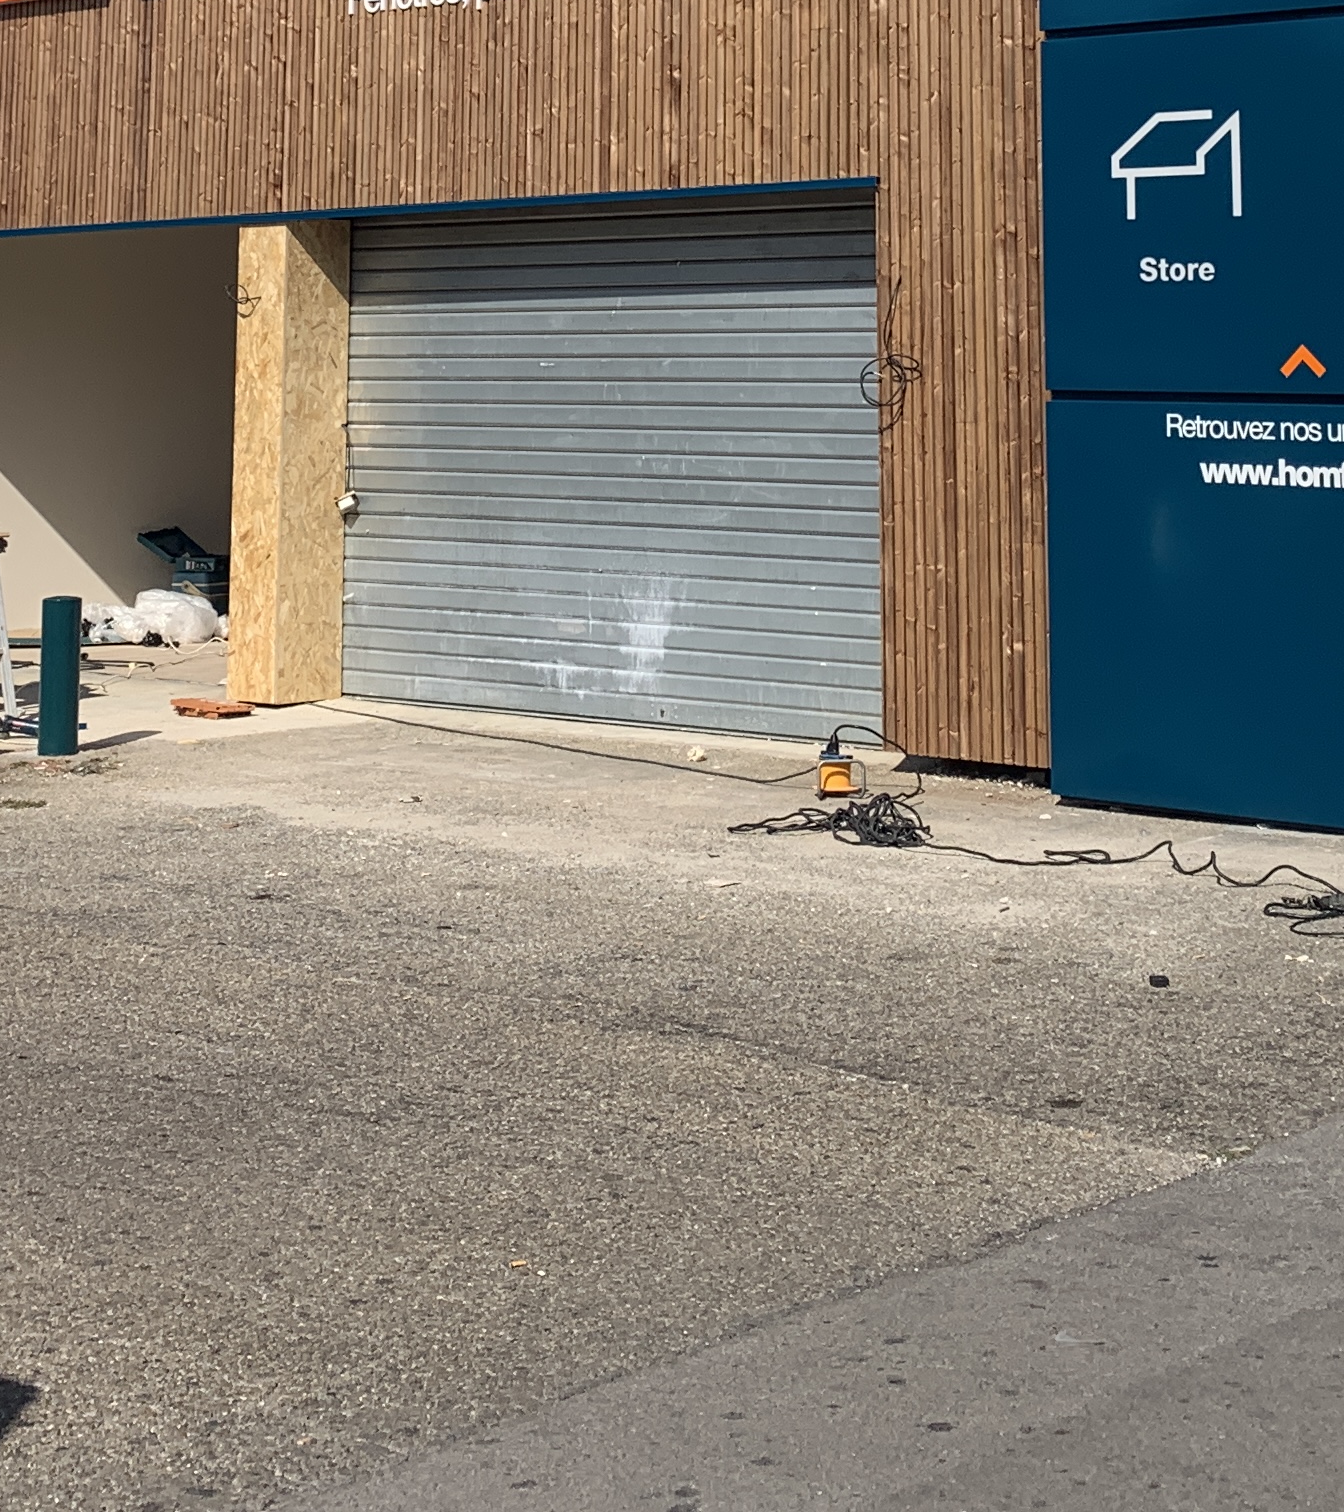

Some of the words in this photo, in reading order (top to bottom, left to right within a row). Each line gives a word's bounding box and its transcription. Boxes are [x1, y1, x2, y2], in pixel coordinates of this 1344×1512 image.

[1139, 257, 1215, 282] Store
[1166, 413, 1276, 441] Retrouvez
[1280, 421, 1323, 442] nos
